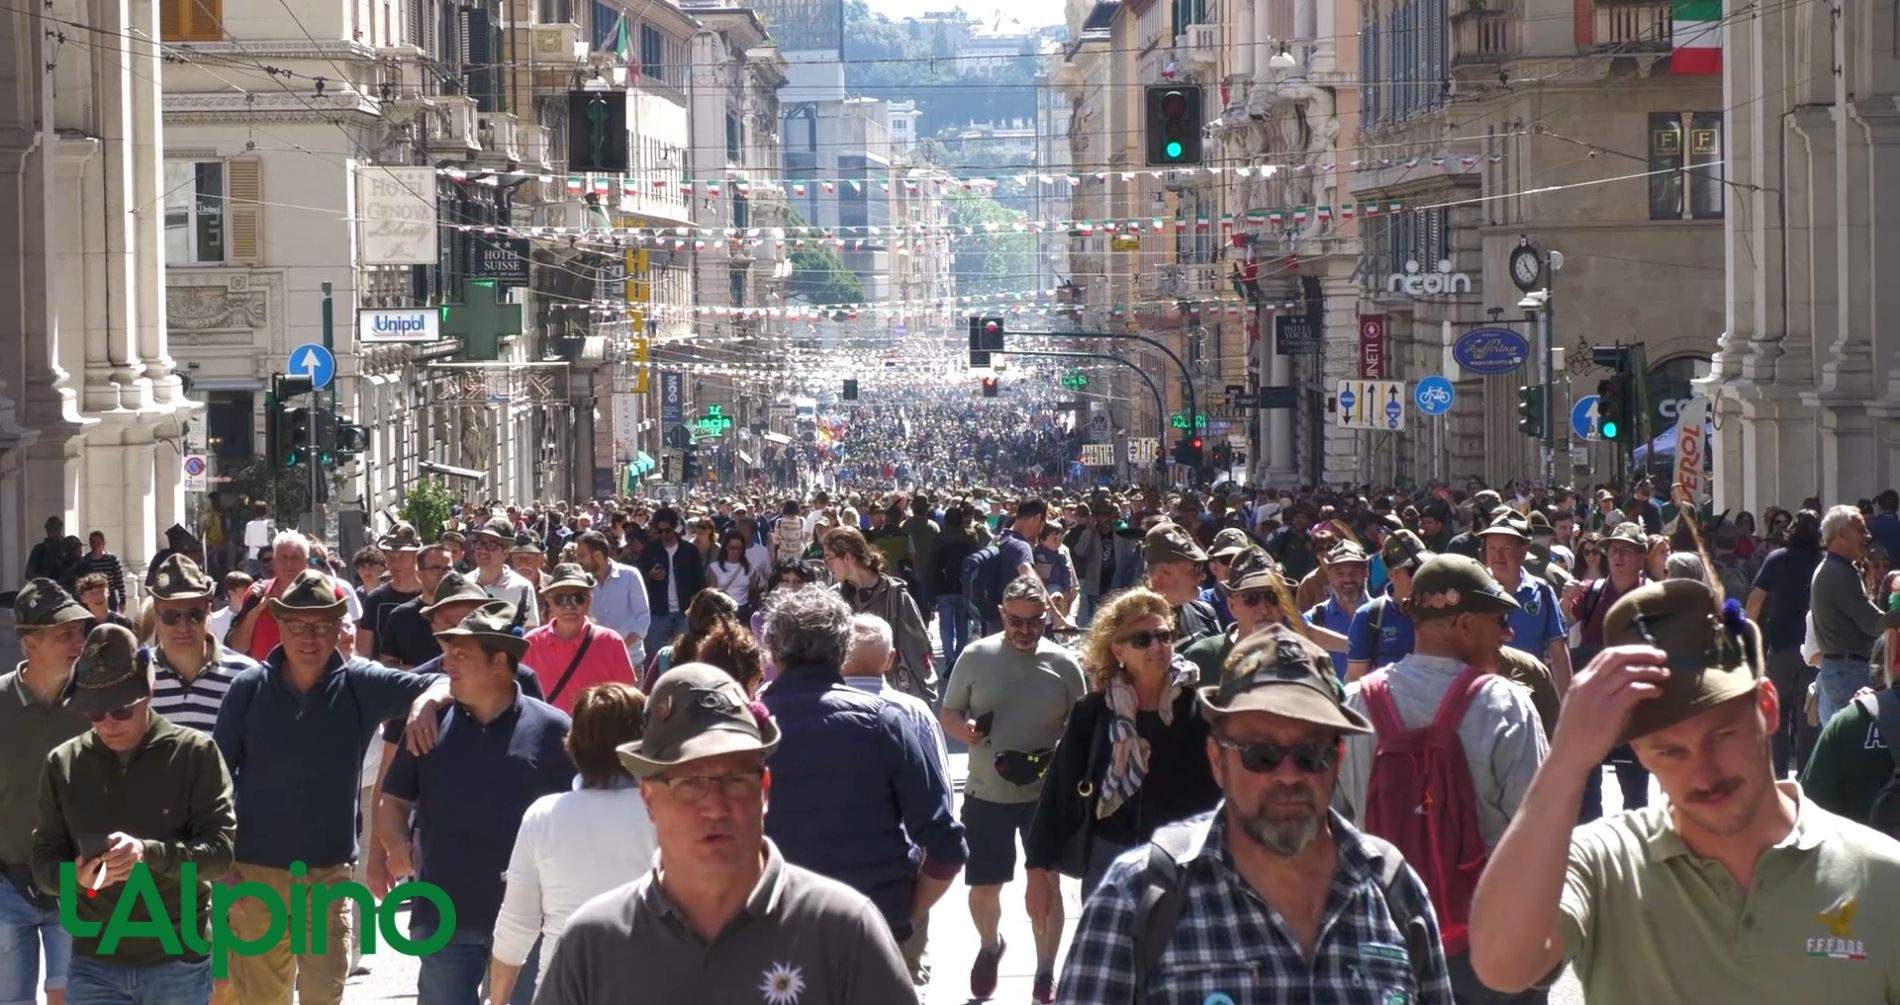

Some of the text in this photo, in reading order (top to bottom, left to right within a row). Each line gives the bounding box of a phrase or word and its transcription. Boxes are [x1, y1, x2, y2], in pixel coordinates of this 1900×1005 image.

[484, 250, 518, 260] HOTEL
[484, 260, 520, 270] SUISSE
[373, 314, 425, 336] Unipol
